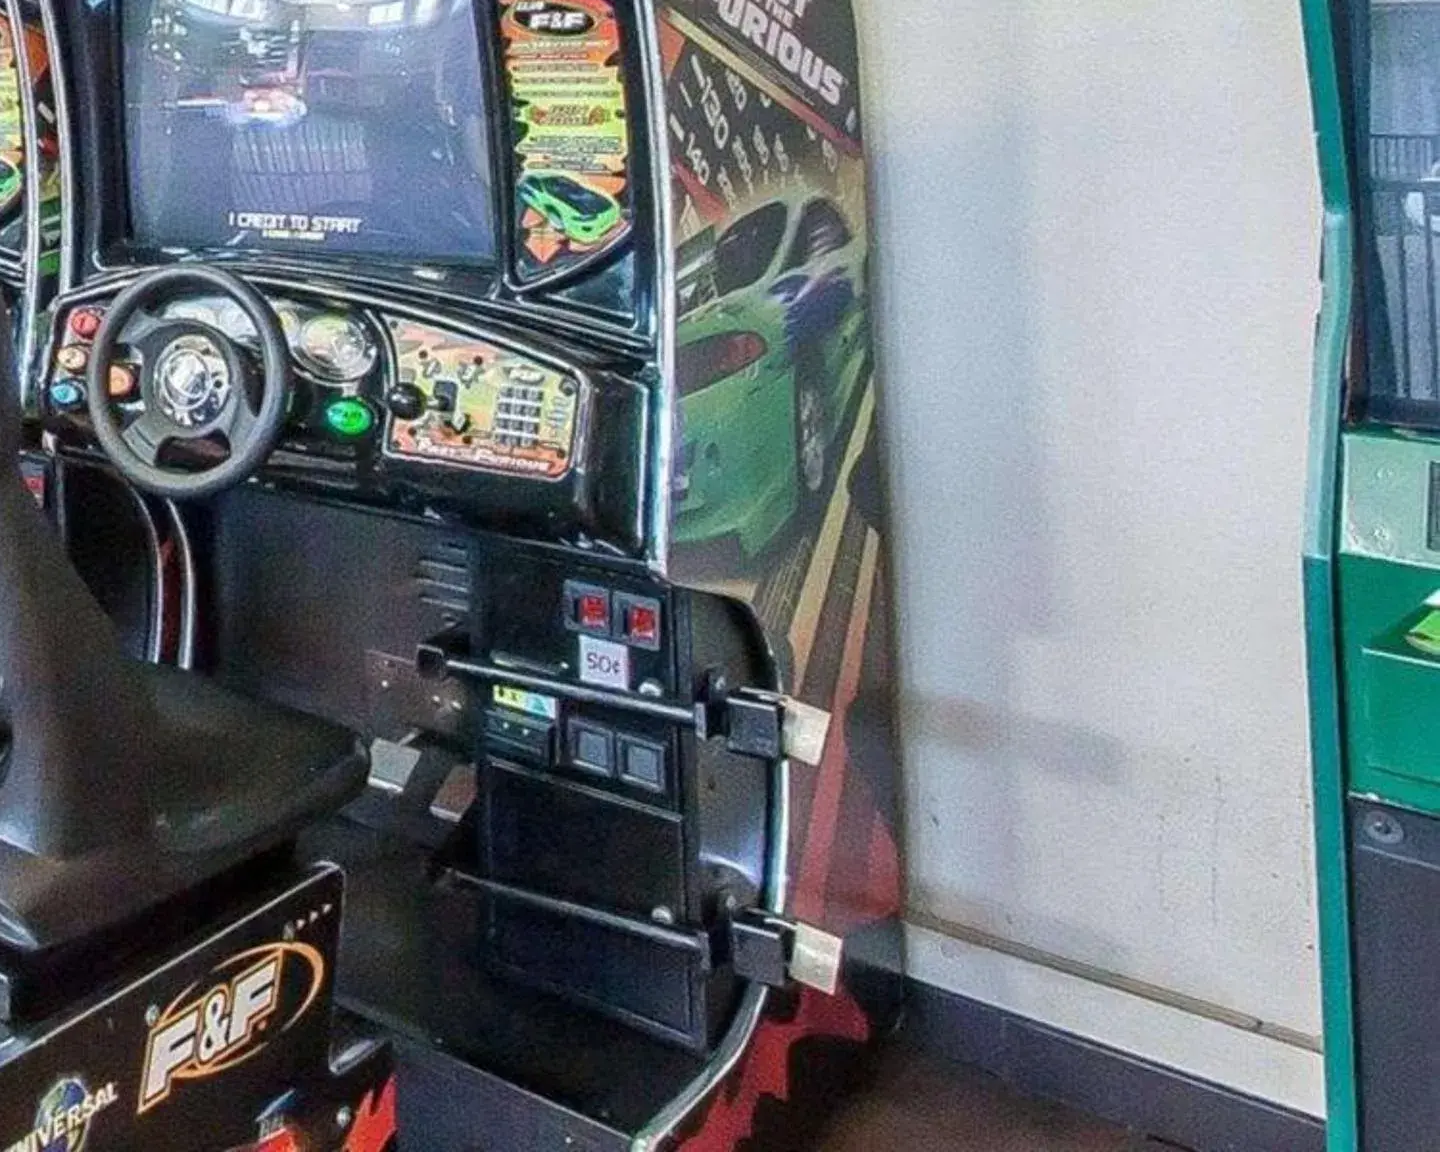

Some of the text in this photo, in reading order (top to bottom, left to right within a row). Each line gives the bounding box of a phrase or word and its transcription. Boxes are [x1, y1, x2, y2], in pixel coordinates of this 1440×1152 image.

[237, 212, 287, 230] CREDIT
[289, 214, 309, 231] TO
[312, 215, 362, 233] START
[141, 958, 278, 1101] F&F
